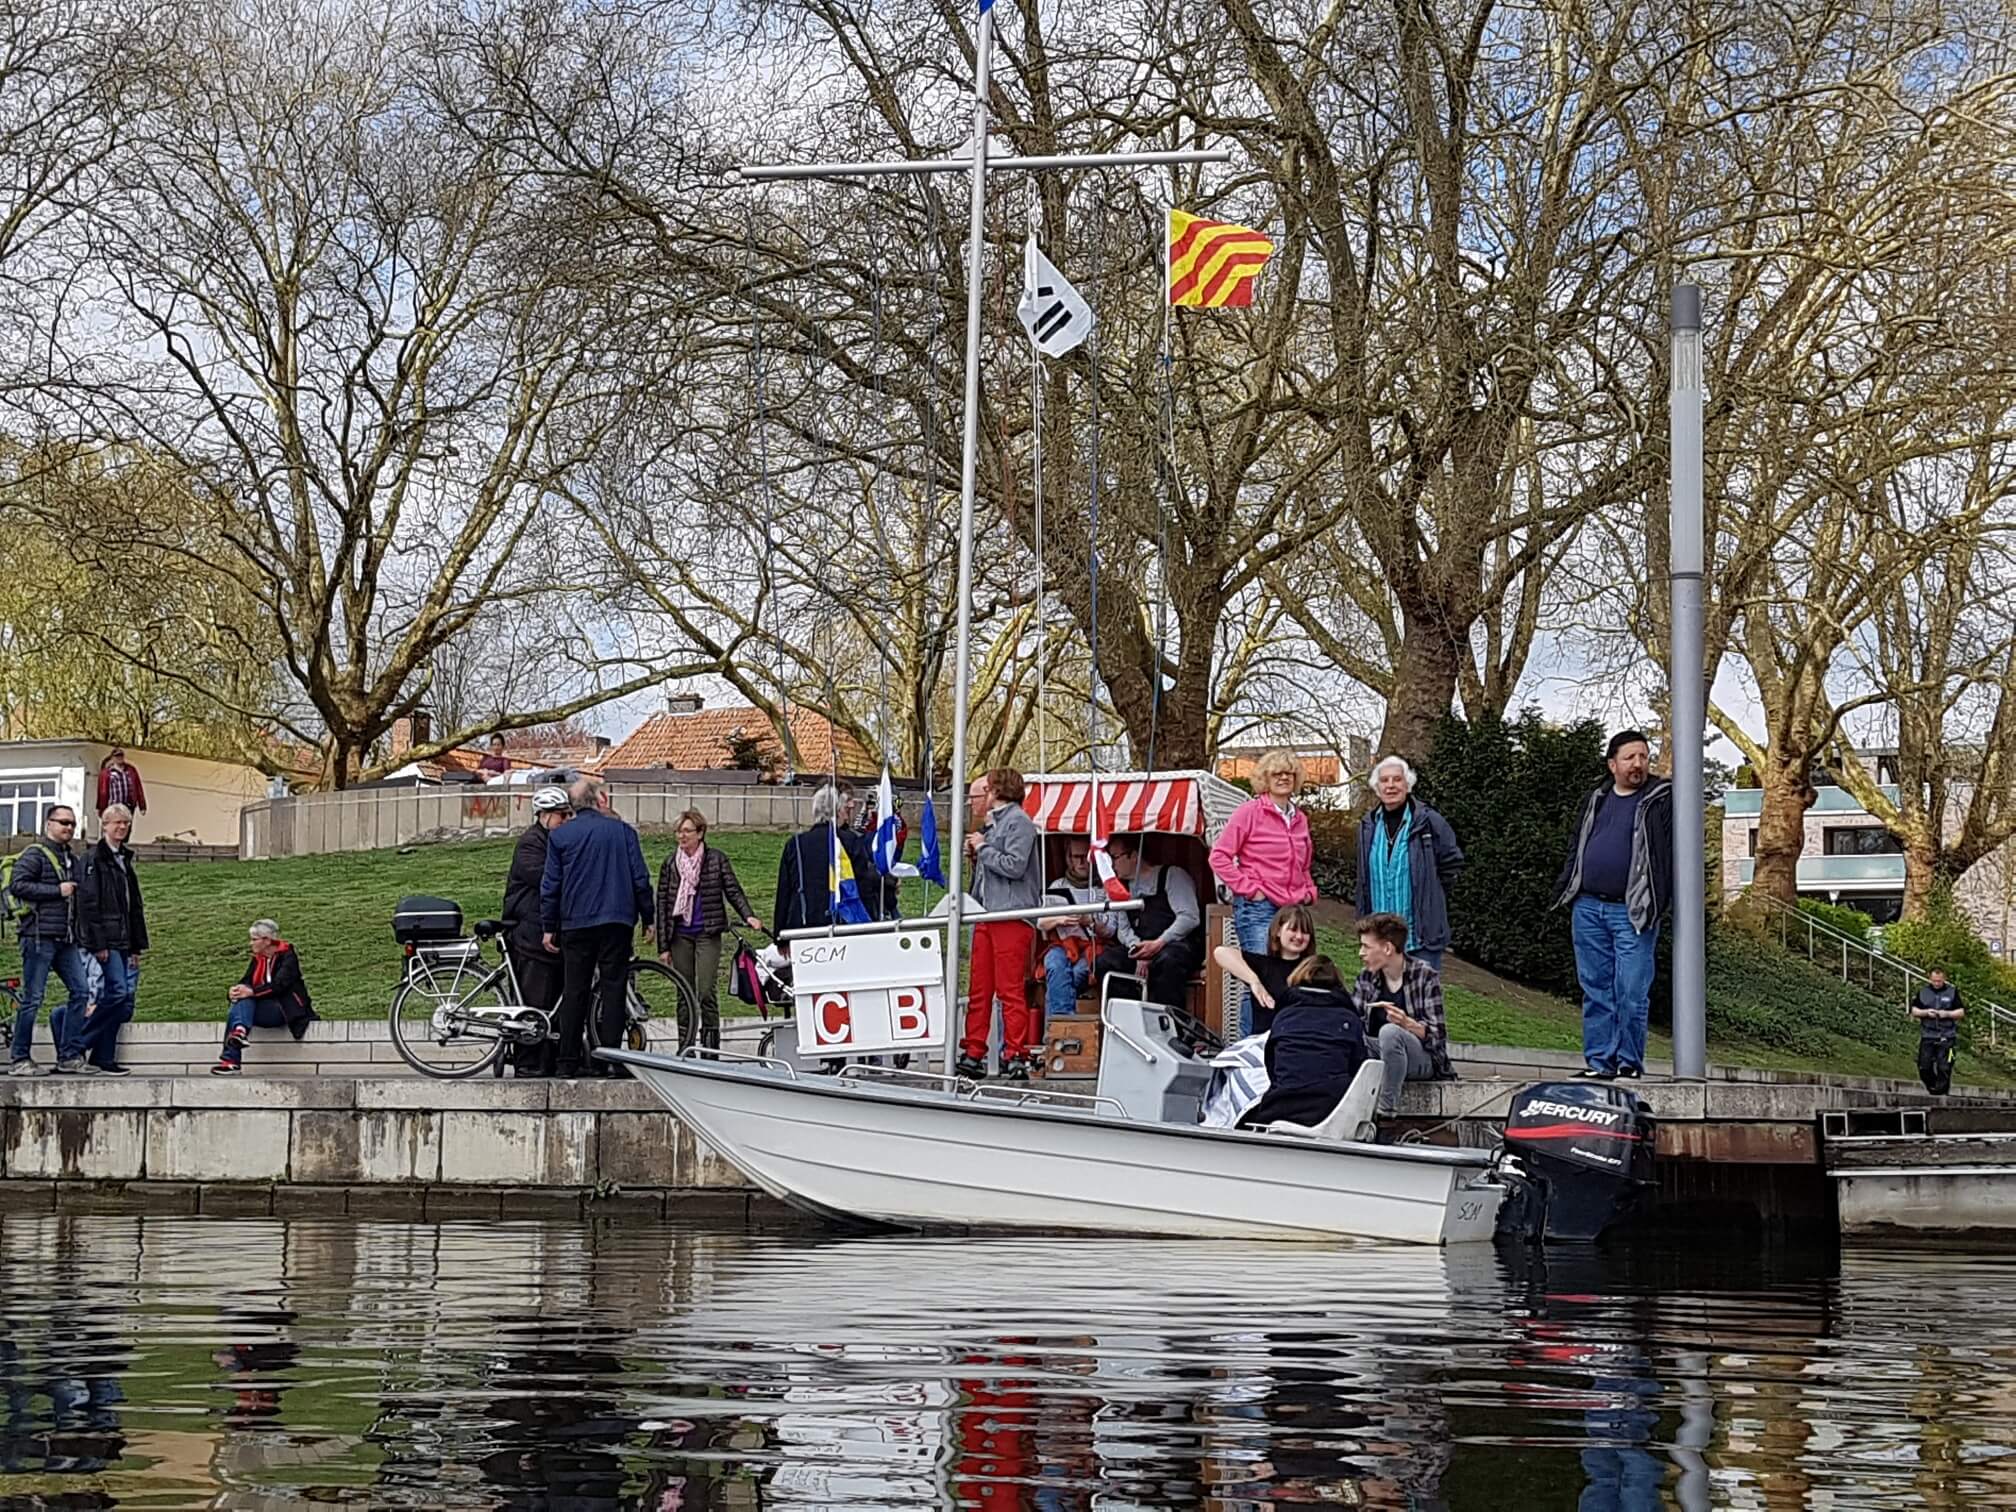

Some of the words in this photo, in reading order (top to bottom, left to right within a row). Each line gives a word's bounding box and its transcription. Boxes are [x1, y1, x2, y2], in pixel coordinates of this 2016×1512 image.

[800, 945, 846, 964] SCM
[814, 992, 850, 1044] C
[891, 986, 928, 1039] B
[1526, 1100, 1619, 1125] MERCURY
